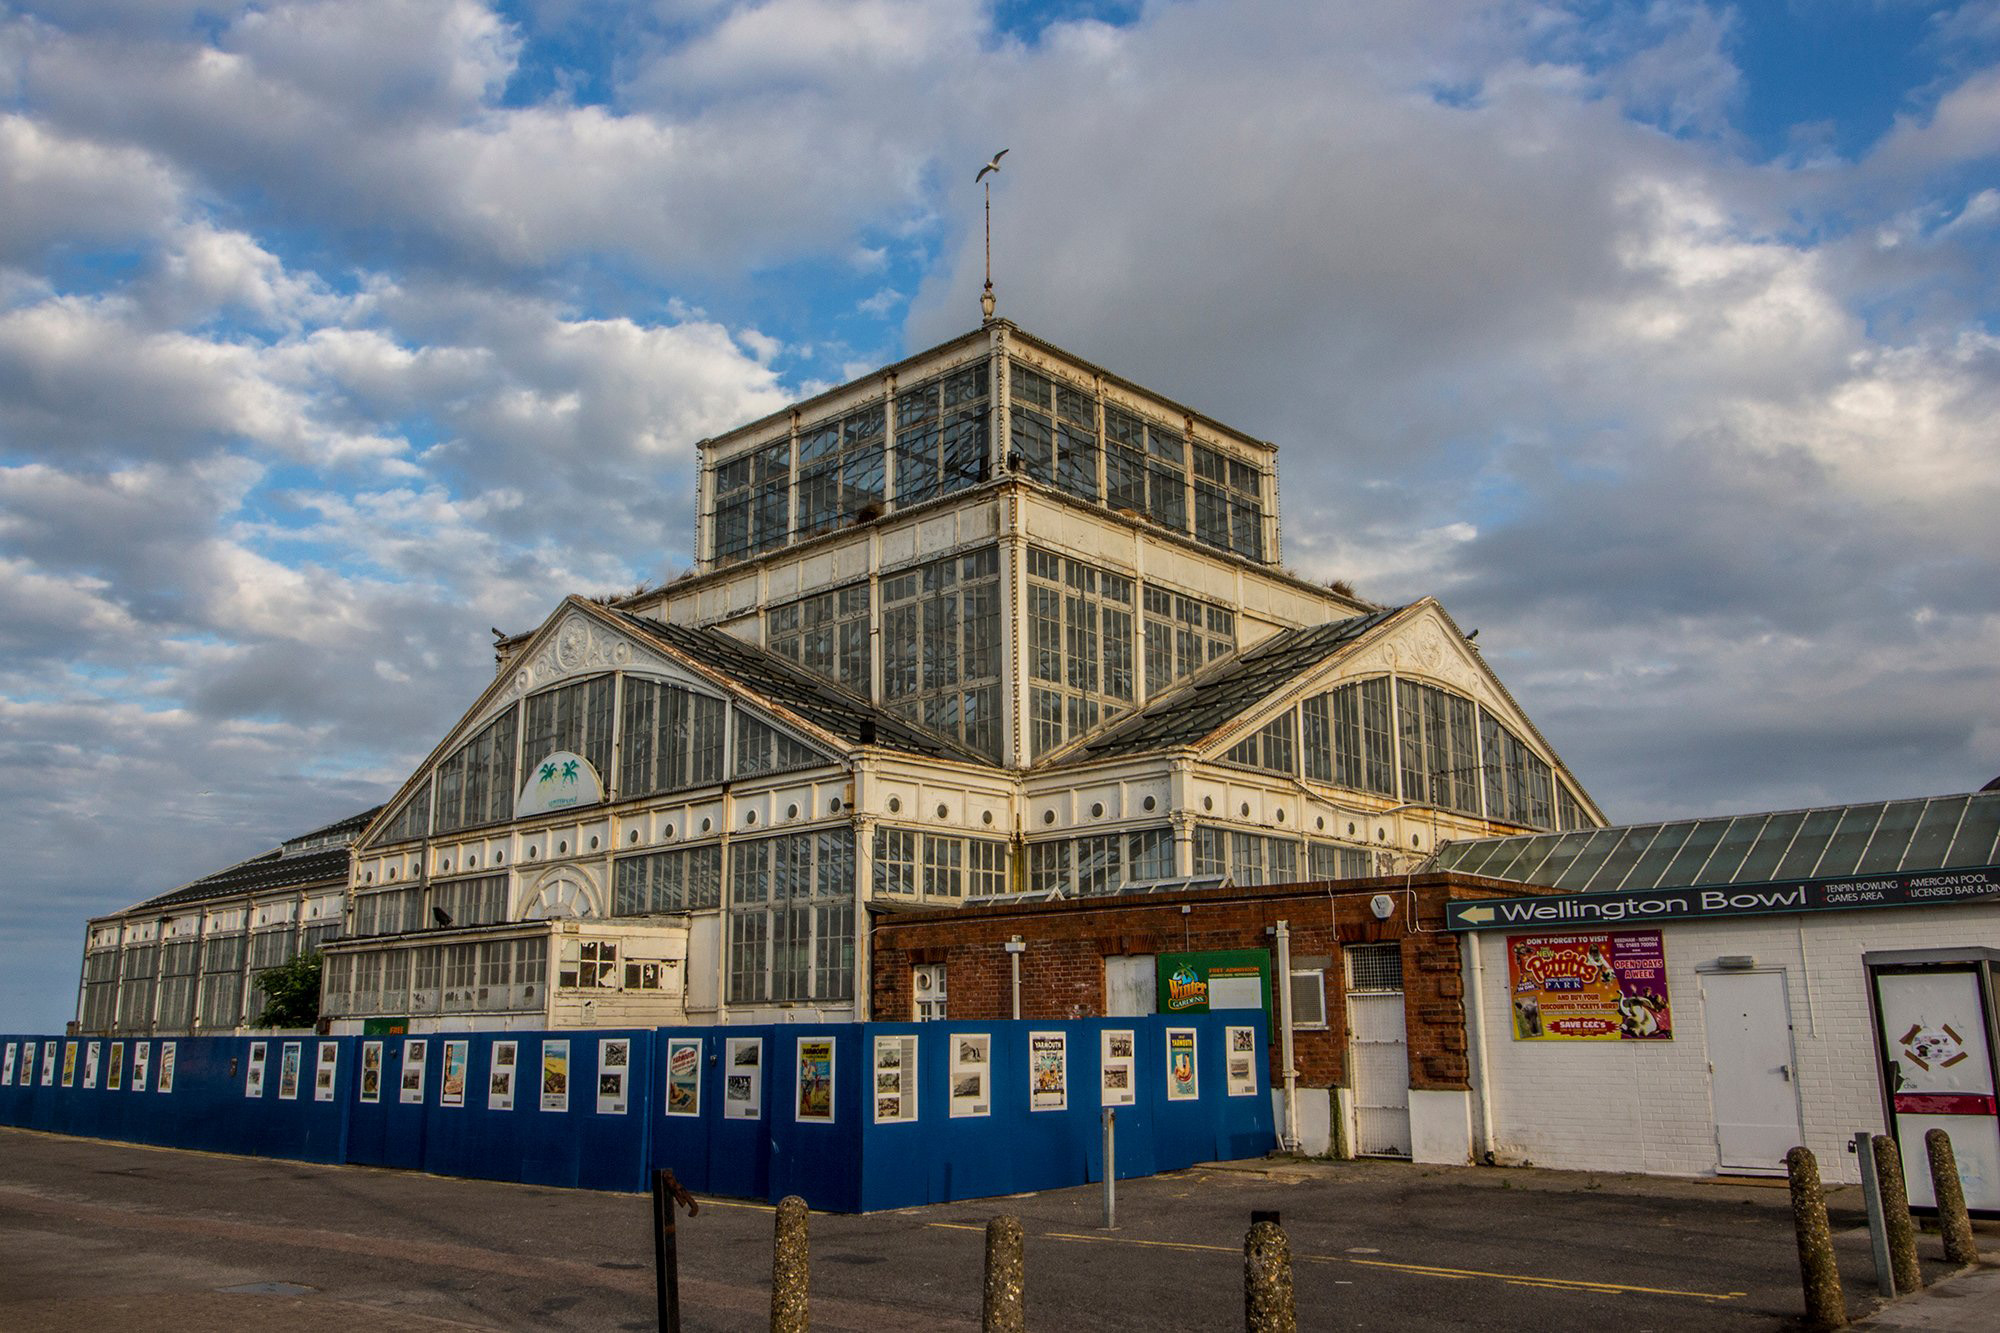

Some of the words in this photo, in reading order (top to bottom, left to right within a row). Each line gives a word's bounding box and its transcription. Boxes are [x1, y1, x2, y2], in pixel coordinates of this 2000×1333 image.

[1825, 883, 1854, 893] TENPIN
[1856, 880, 1898, 891] BOWLING
[1910, 876, 1958, 887] AMERICAN
[1960, 874, 1988, 884] POOL
[1826, 893, 1858, 903] GAMES
[1860, 891, 1884, 901] AREA
[1910, 887, 1952, 898] LICENSED
[1955, 885, 1974, 895] BAR
[1976, 885, 1984, 893] &
[1500, 897, 1688, 921] Wellington
[1701, 886, 1806, 911] Bowl
[1614, 960, 1635, 969] OPEN
[1642, 959, 1663, 968] DAYS
[1625, 970, 1631, 979] A
[1631, 969, 1655, 979] WEEK
[1168, 978, 1207, 999] Winter
[1545, 981, 1581, 989] PARK
[1172, 996, 1205, 1008] GARDENS
[1576, 1002, 1600, 1010] TICKETS
[389, 1026, 404, 1034] FREE
